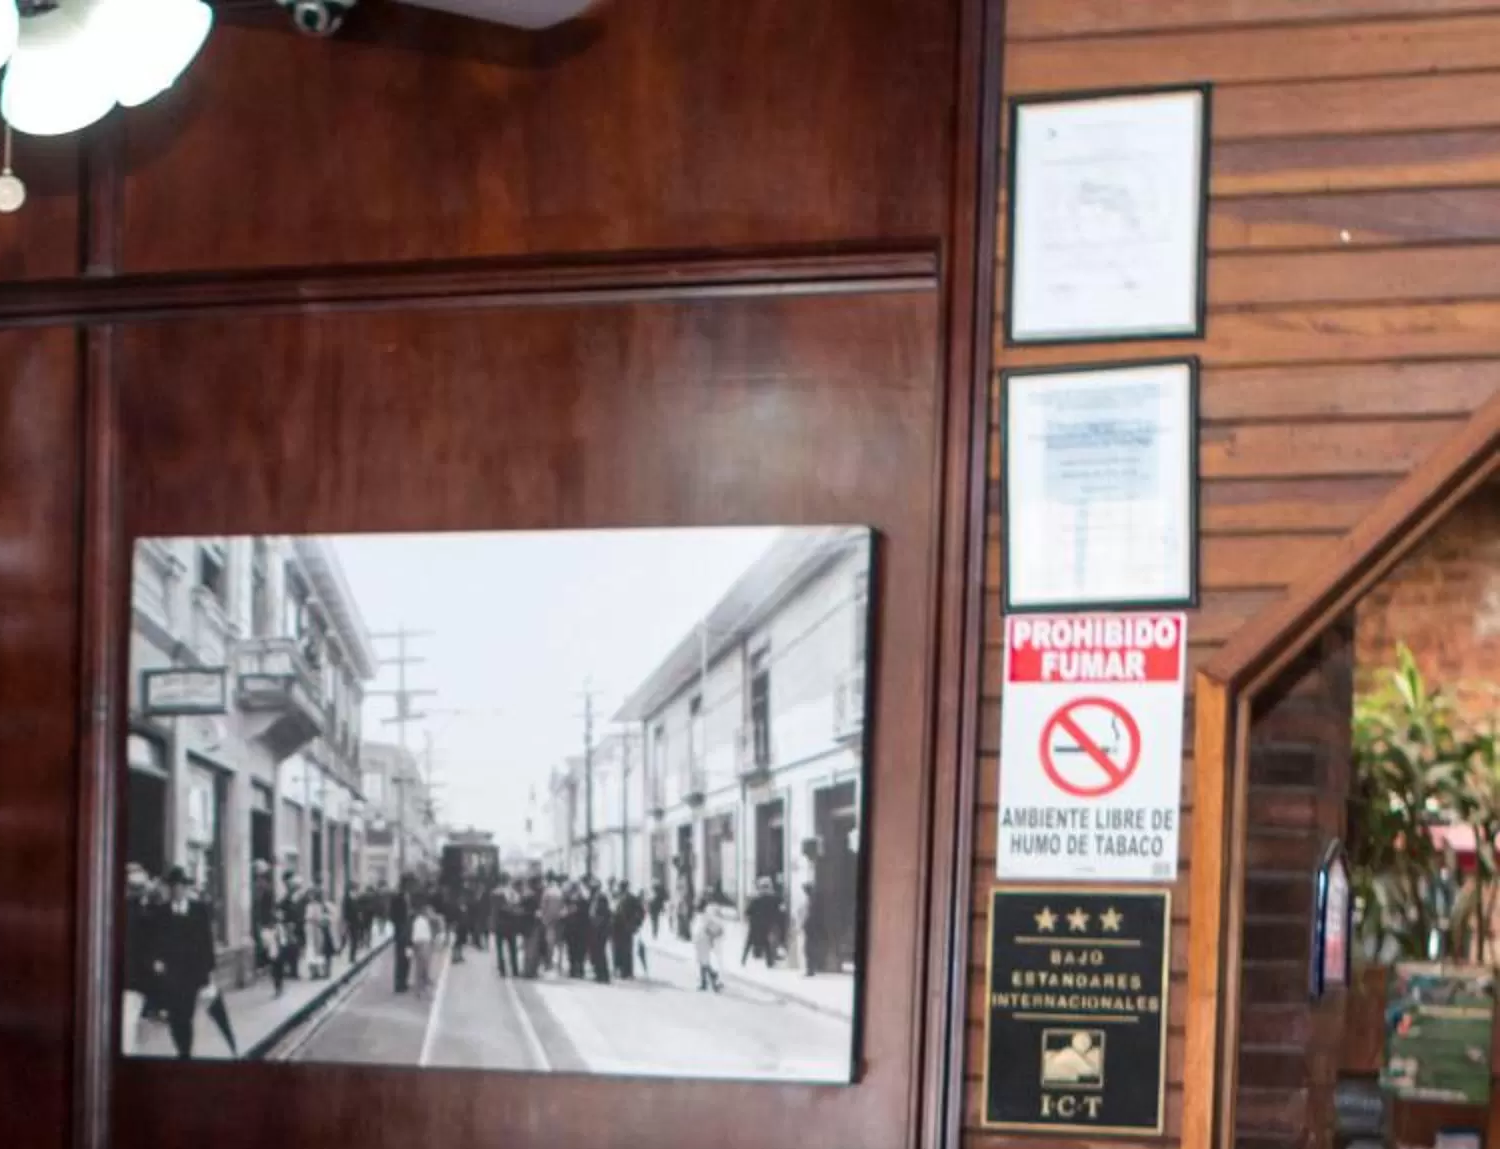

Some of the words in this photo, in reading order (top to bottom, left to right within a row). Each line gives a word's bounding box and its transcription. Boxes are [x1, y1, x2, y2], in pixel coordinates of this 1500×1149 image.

[1013, 616, 1177, 649] PROHIBIDO
[1041, 650, 1146, 679] FUMAR
[1002, 806, 1089, 829] AMBIENTE
[1095, 808, 1145, 830] LIBRE
[1151, 809, 1173, 831] DE
[1010, 833, 1061, 854] HUMO
[1067, 834, 1089, 855] DE
[1095, 835, 1164, 856] TABACO
[1050, 949, 1104, 966] BAJO
[1011, 970, 1142, 991] ESTANDARES
[992, 993, 1160, 1013] INTERNACIONALES
